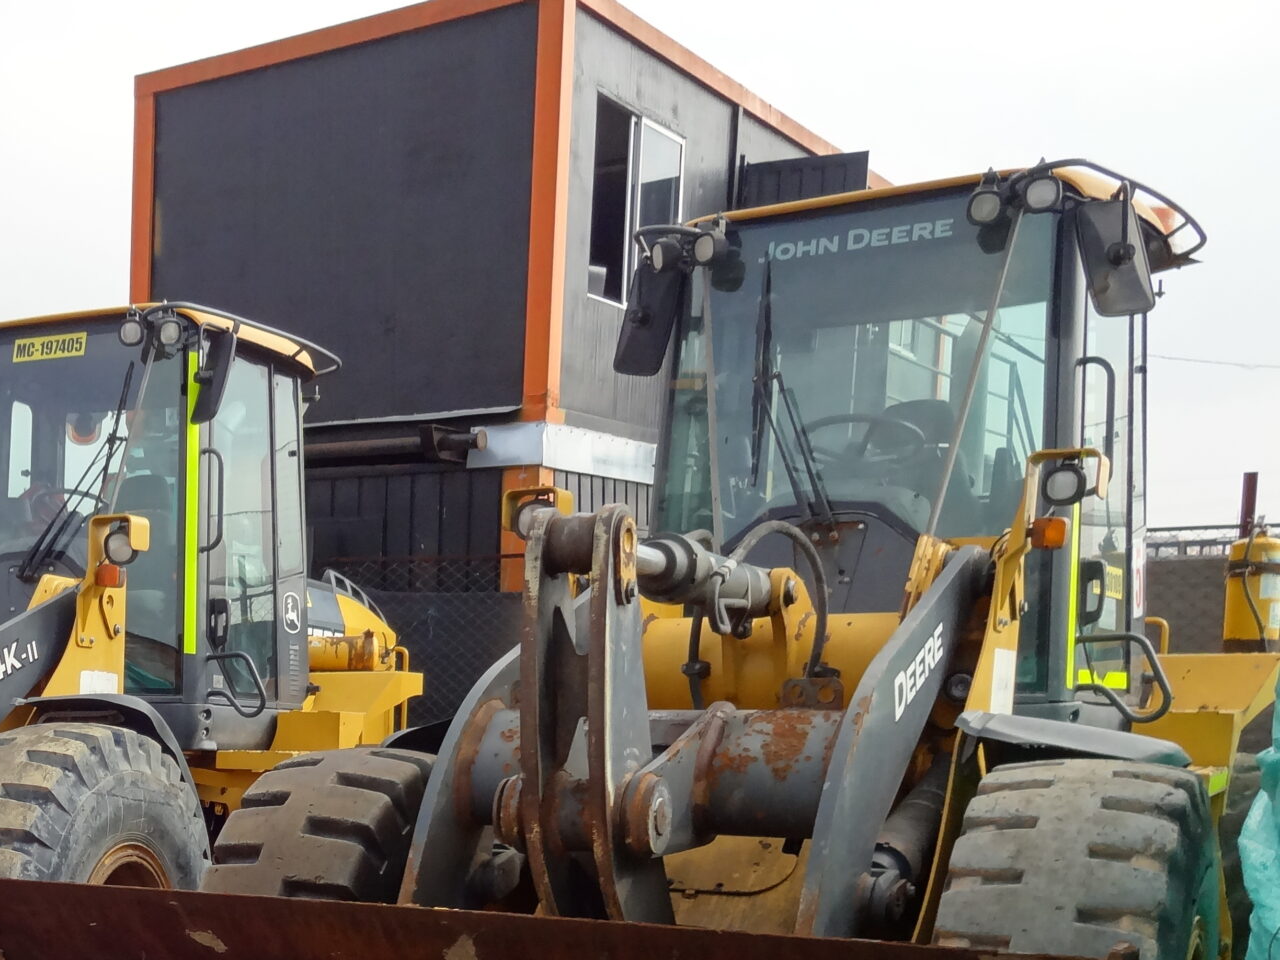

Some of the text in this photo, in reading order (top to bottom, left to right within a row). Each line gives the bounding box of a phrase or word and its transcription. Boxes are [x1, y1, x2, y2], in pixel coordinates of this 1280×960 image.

[758, 218, 955, 263] JOHN DEERE
[15, 336, 84, 359] MC-197405
[894, 621, 944, 722] DEERE
